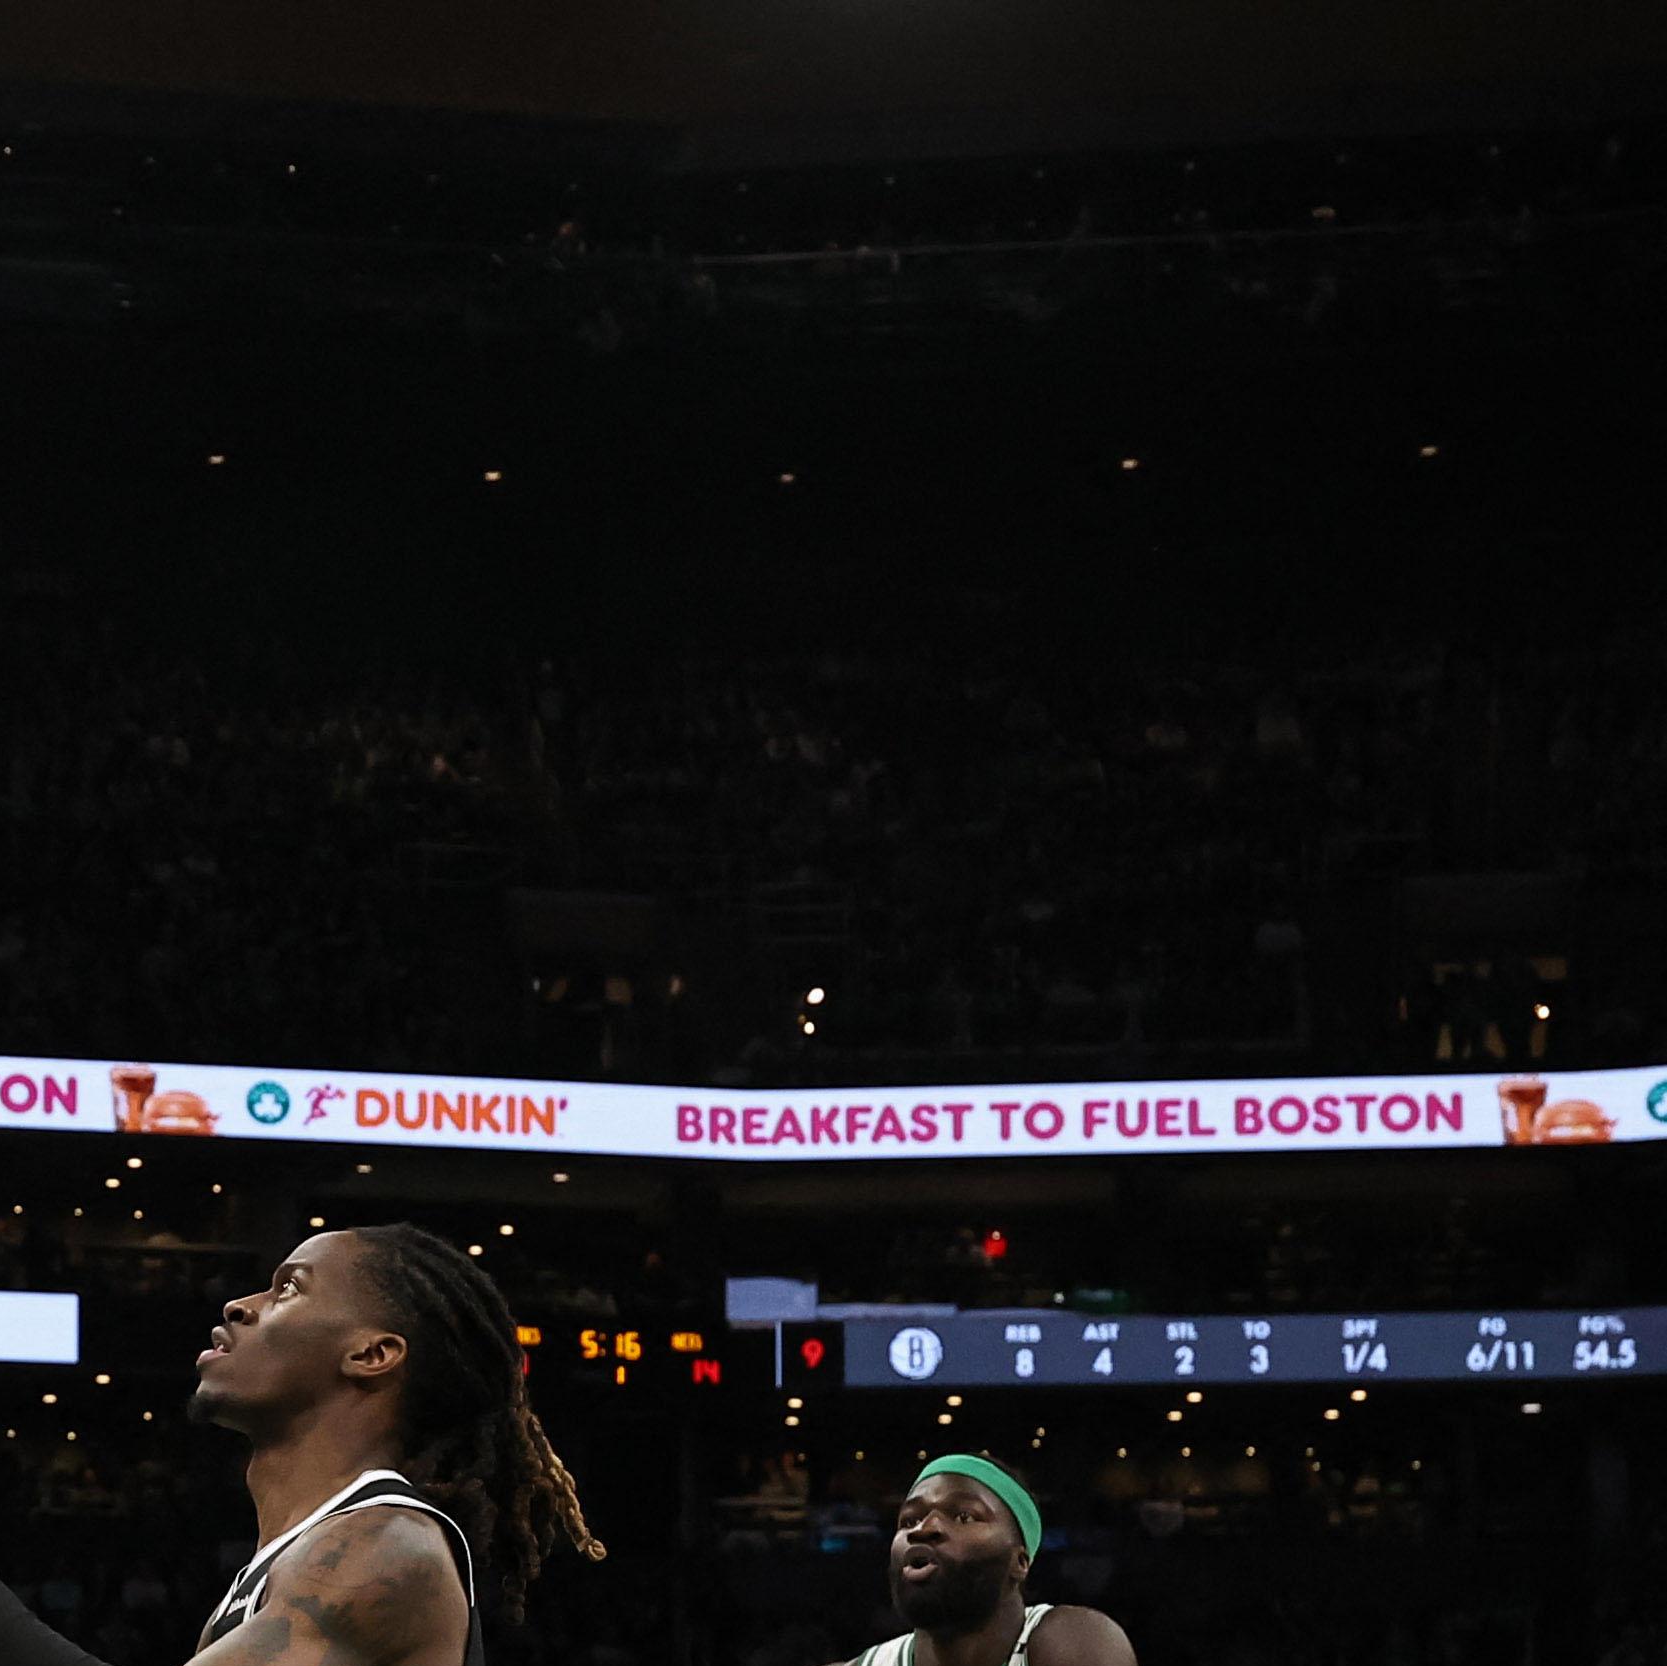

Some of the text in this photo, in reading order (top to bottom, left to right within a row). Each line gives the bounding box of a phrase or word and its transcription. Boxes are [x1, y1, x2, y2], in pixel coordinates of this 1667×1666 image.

[356, 1088, 568, 1137] DUNKIN'
[677, 1093, 1463, 1146] BREAKFAST TO FUEL BOSTON
[579, 1329, 642, 1360] 5:16
[1015, 1339, 1637, 1377] 8 4 2 3 1/4 6/11 54.5
